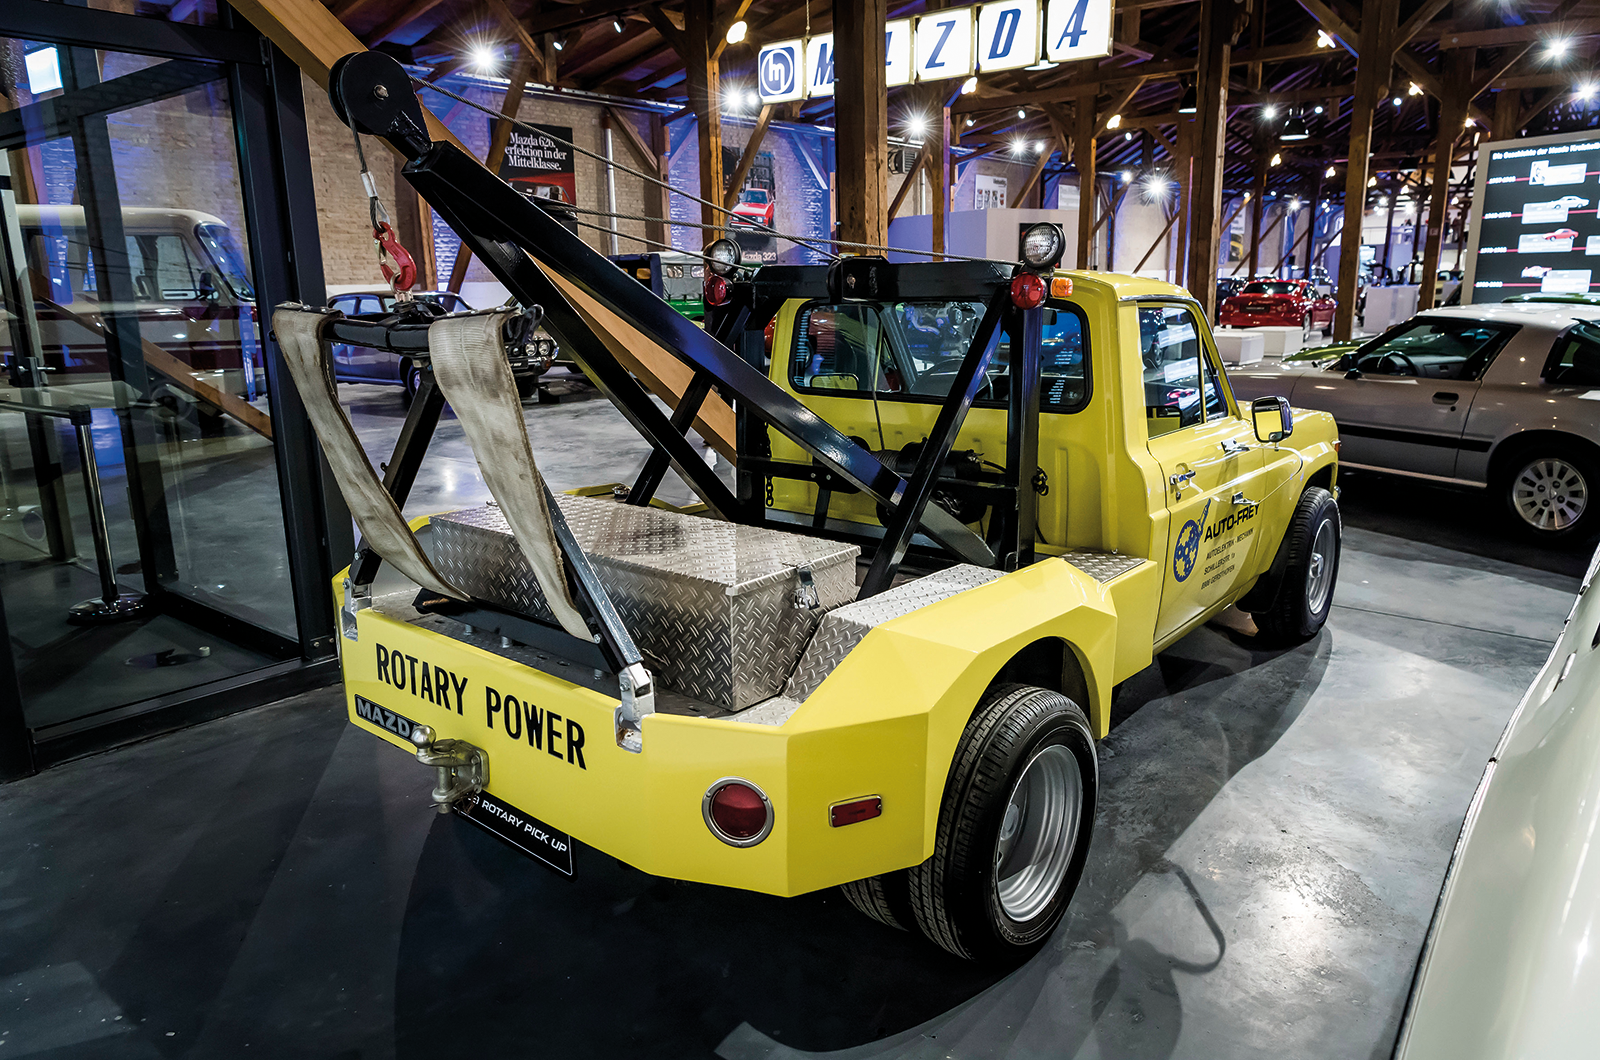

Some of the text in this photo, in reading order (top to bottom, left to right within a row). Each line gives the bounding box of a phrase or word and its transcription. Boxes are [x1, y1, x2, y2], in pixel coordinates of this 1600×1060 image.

[504, 144, 567, 160] erfektion in der
[509, 132, 538, 146] Mazda
[508, 154, 562, 171] Mittelklasse.
[762, 251, 777, 261] 323
[1203, 501, 1261, 543] AUTO-FREY
[357, 698, 417, 738] MAZD
[375, 643, 588, 771] ROTARY POWER
[481, 799, 524, 828] ROTARY
[524, 823, 550, 845] PICK
[550, 838, 568, 852] UP
